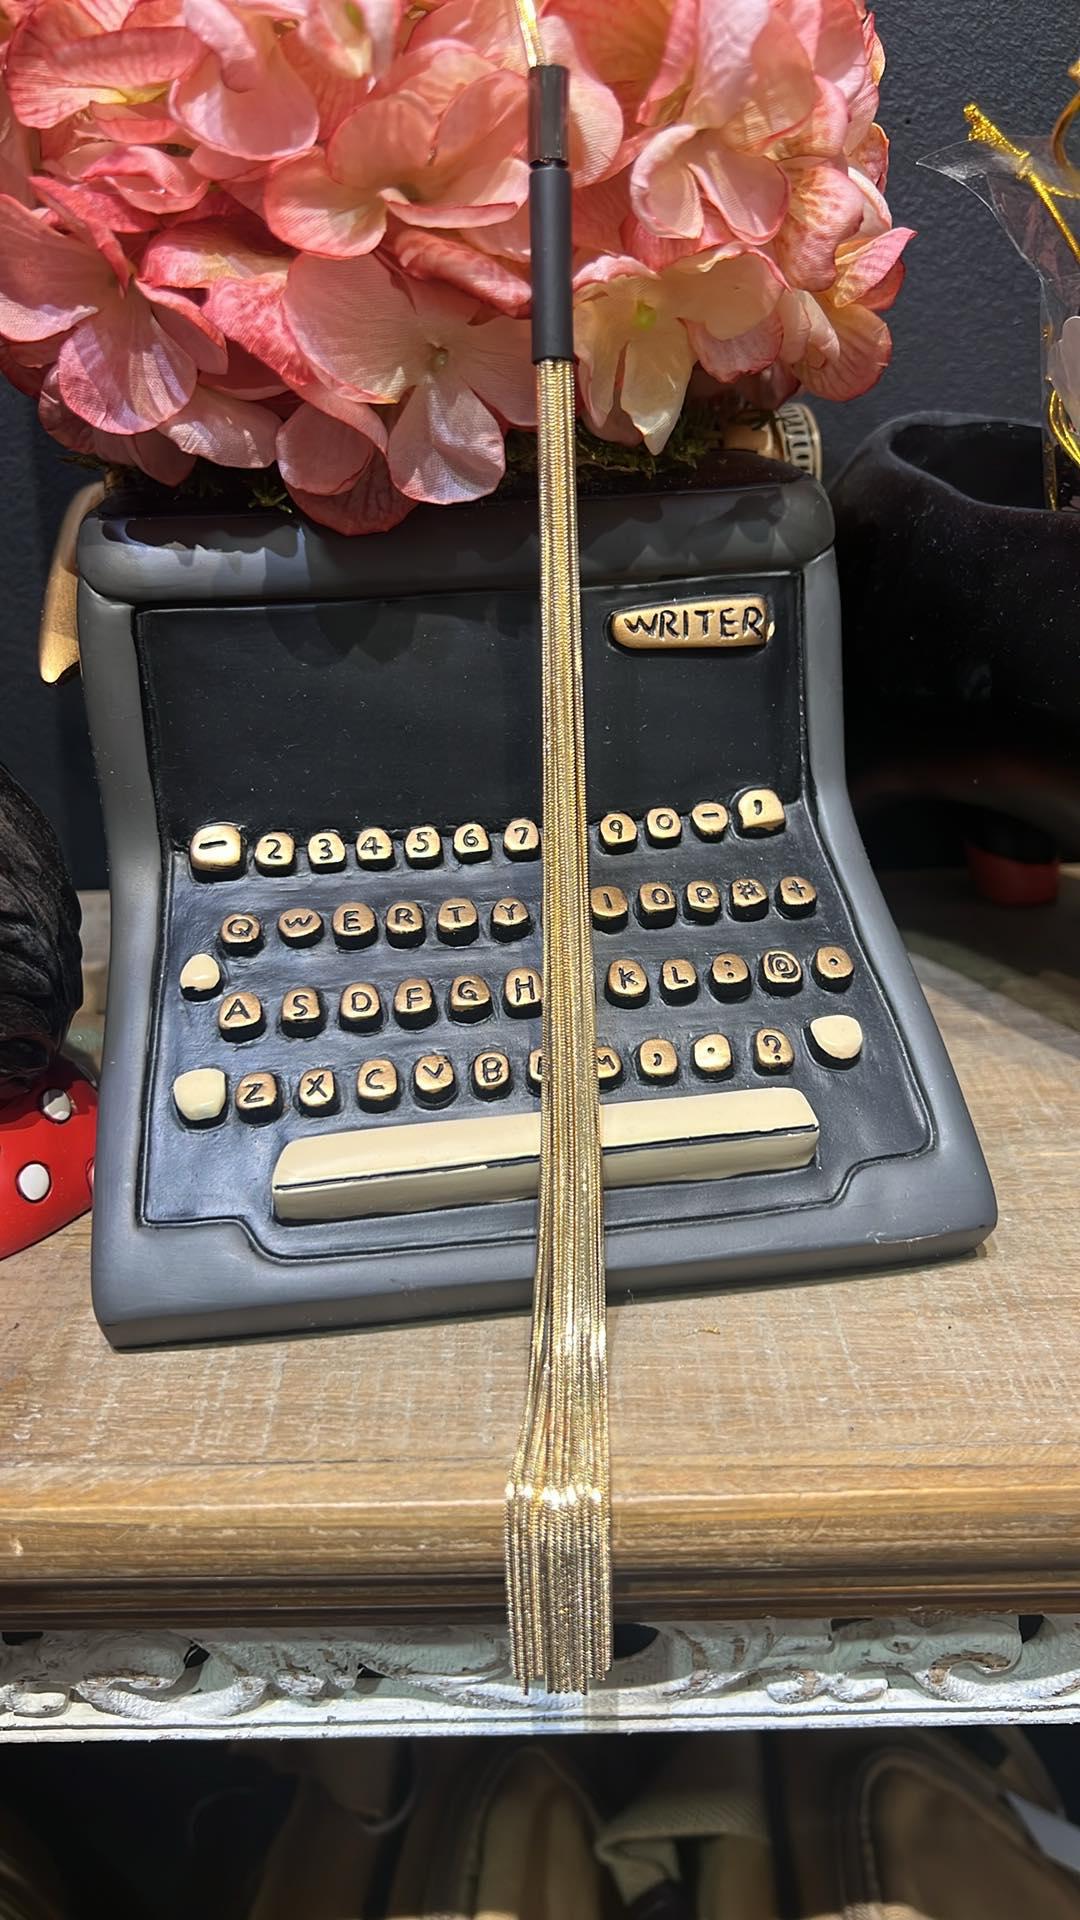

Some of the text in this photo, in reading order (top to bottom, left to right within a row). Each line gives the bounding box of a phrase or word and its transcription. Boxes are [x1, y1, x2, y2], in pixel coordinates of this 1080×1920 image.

[623, 606, 764, 639] WRITER
[265, 838, 283, 860] 2
[318, 838, 334, 860] 3
[360, 836, 384, 855] 4
[412, 831, 431, 852] 5
[463, 827, 479, 847] 6
[513, 826, 530, 845] 7
[608, 819, 624, 839] 9
[228, 920, 251, 937] Q
[284, 915, 314, 929] W
[343, 910, 361, 932] E
[395, 908, 415, 926] R
[447, 905, 466, 923] T
[499, 903, 518, 921] Y
[695, 886, 712, 903] P
[223, 998, 251, 1021] A
[291, 994, 309, 1017] S
[350, 991, 372, 1012] D
[405, 987, 423, 1009] F
[457, 980, 480, 1000] G
[513, 975, 536, 1002] H
[617, 967, 636, 990] K
[671, 966, 688, 984] L
[240, 1083, 265, 1104] Z
[308, 1073, 328, 1098] X
[365, 1068, 385, 1090] C
[422, 1062, 443, 1078] V
[482, 1056, 503, 1083] B
[762, 1034, 782, 1062] ?
